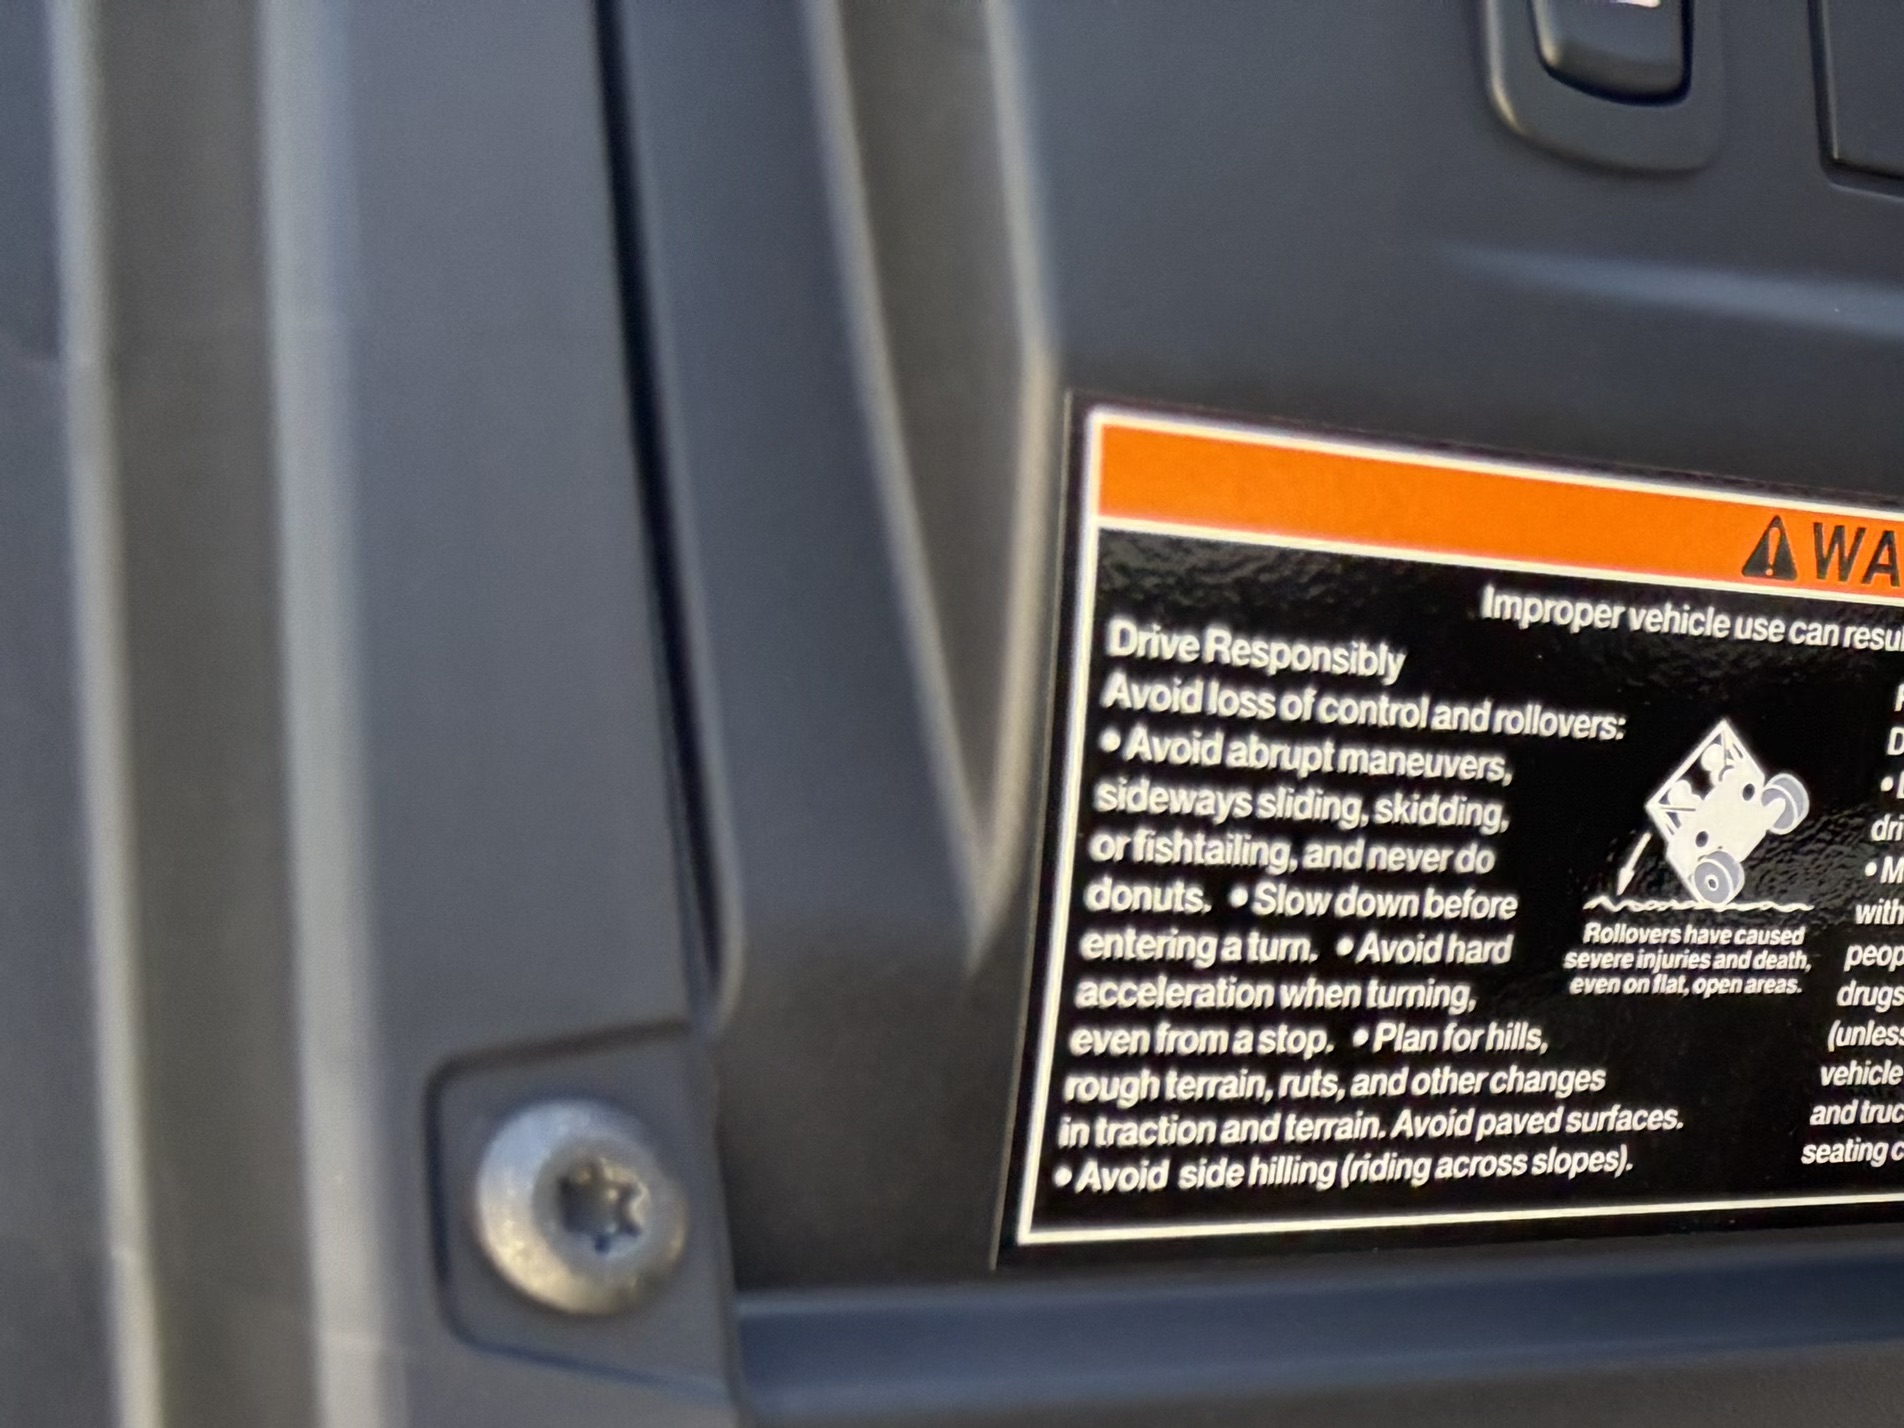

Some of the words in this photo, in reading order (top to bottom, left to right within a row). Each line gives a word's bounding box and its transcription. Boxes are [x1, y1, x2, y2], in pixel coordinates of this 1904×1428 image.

[1480, 583, 1626, 634] Improper
[1627, 601, 1732, 638] vehicle
[1732, 615, 1786, 643] use
[1787, 620, 1841, 647] can
[1106, 620, 1201, 663] Drive
[1201, 628, 1407, 686] Responsibly
[1100, 673, 1204, 714] Avoid
[1206, 680, 1277, 720] loss
[1277, 686, 1317, 721] of
[1315, 693, 1430, 729] control
[1429, 698, 1493, 733] and
[1491, 702, 1627, 740] rollovers:
[1122, 727, 1225, 766] Avoid
[1224, 734, 1336, 778] abrupt
[1336, 746, 1513, 786] maneuvers,
[1094, 778, 1253, 825] sideways
[1255, 785, 1370, 830] sliding,
[1372, 791, 1510, 835] skidding,
[1582, 921, 1682, 945] Rollovers
[1682, 923, 1733, 945] have
[1732, 924, 1807, 946] caused
[1562, 950, 1635, 970] severe
[1634, 947, 1712, 975] injuries
[1711, 948, 1753, 970] and
[1751, 949, 1812, 972] death,
[1568, 976, 1622, 994] even
[1621, 976, 1651, 994] on
[1651, 973, 1690, 997] flat,
[1691, 976, 1744, 999] open
[1743, 976, 1803, 994] areas.
[1074, 975, 1276, 1009] acceleration
[1278, 975, 1363, 1009] when
[1365, 977, 1477, 1015] turning,
[1063, 1068, 1161, 1109] rough
[1164, 1067, 1274, 1103] terrain,
[1277, 1067, 1346, 1102] ruts,
[1349, 1065, 1410, 1098] and
[1409, 1064, 1490, 1096] other
[1488, 1063, 1607, 1099] changes
[1074, 1158, 1171, 1193] Avoid
[1177, 1156, 1246, 1190] side
[1247, 1154, 1338, 1190] hilling
[1339, 1151, 1433, 1189] (riding
[1433, 1152, 1529, 1179] across
[1530, 1143, 1634, 1180] slopes).
